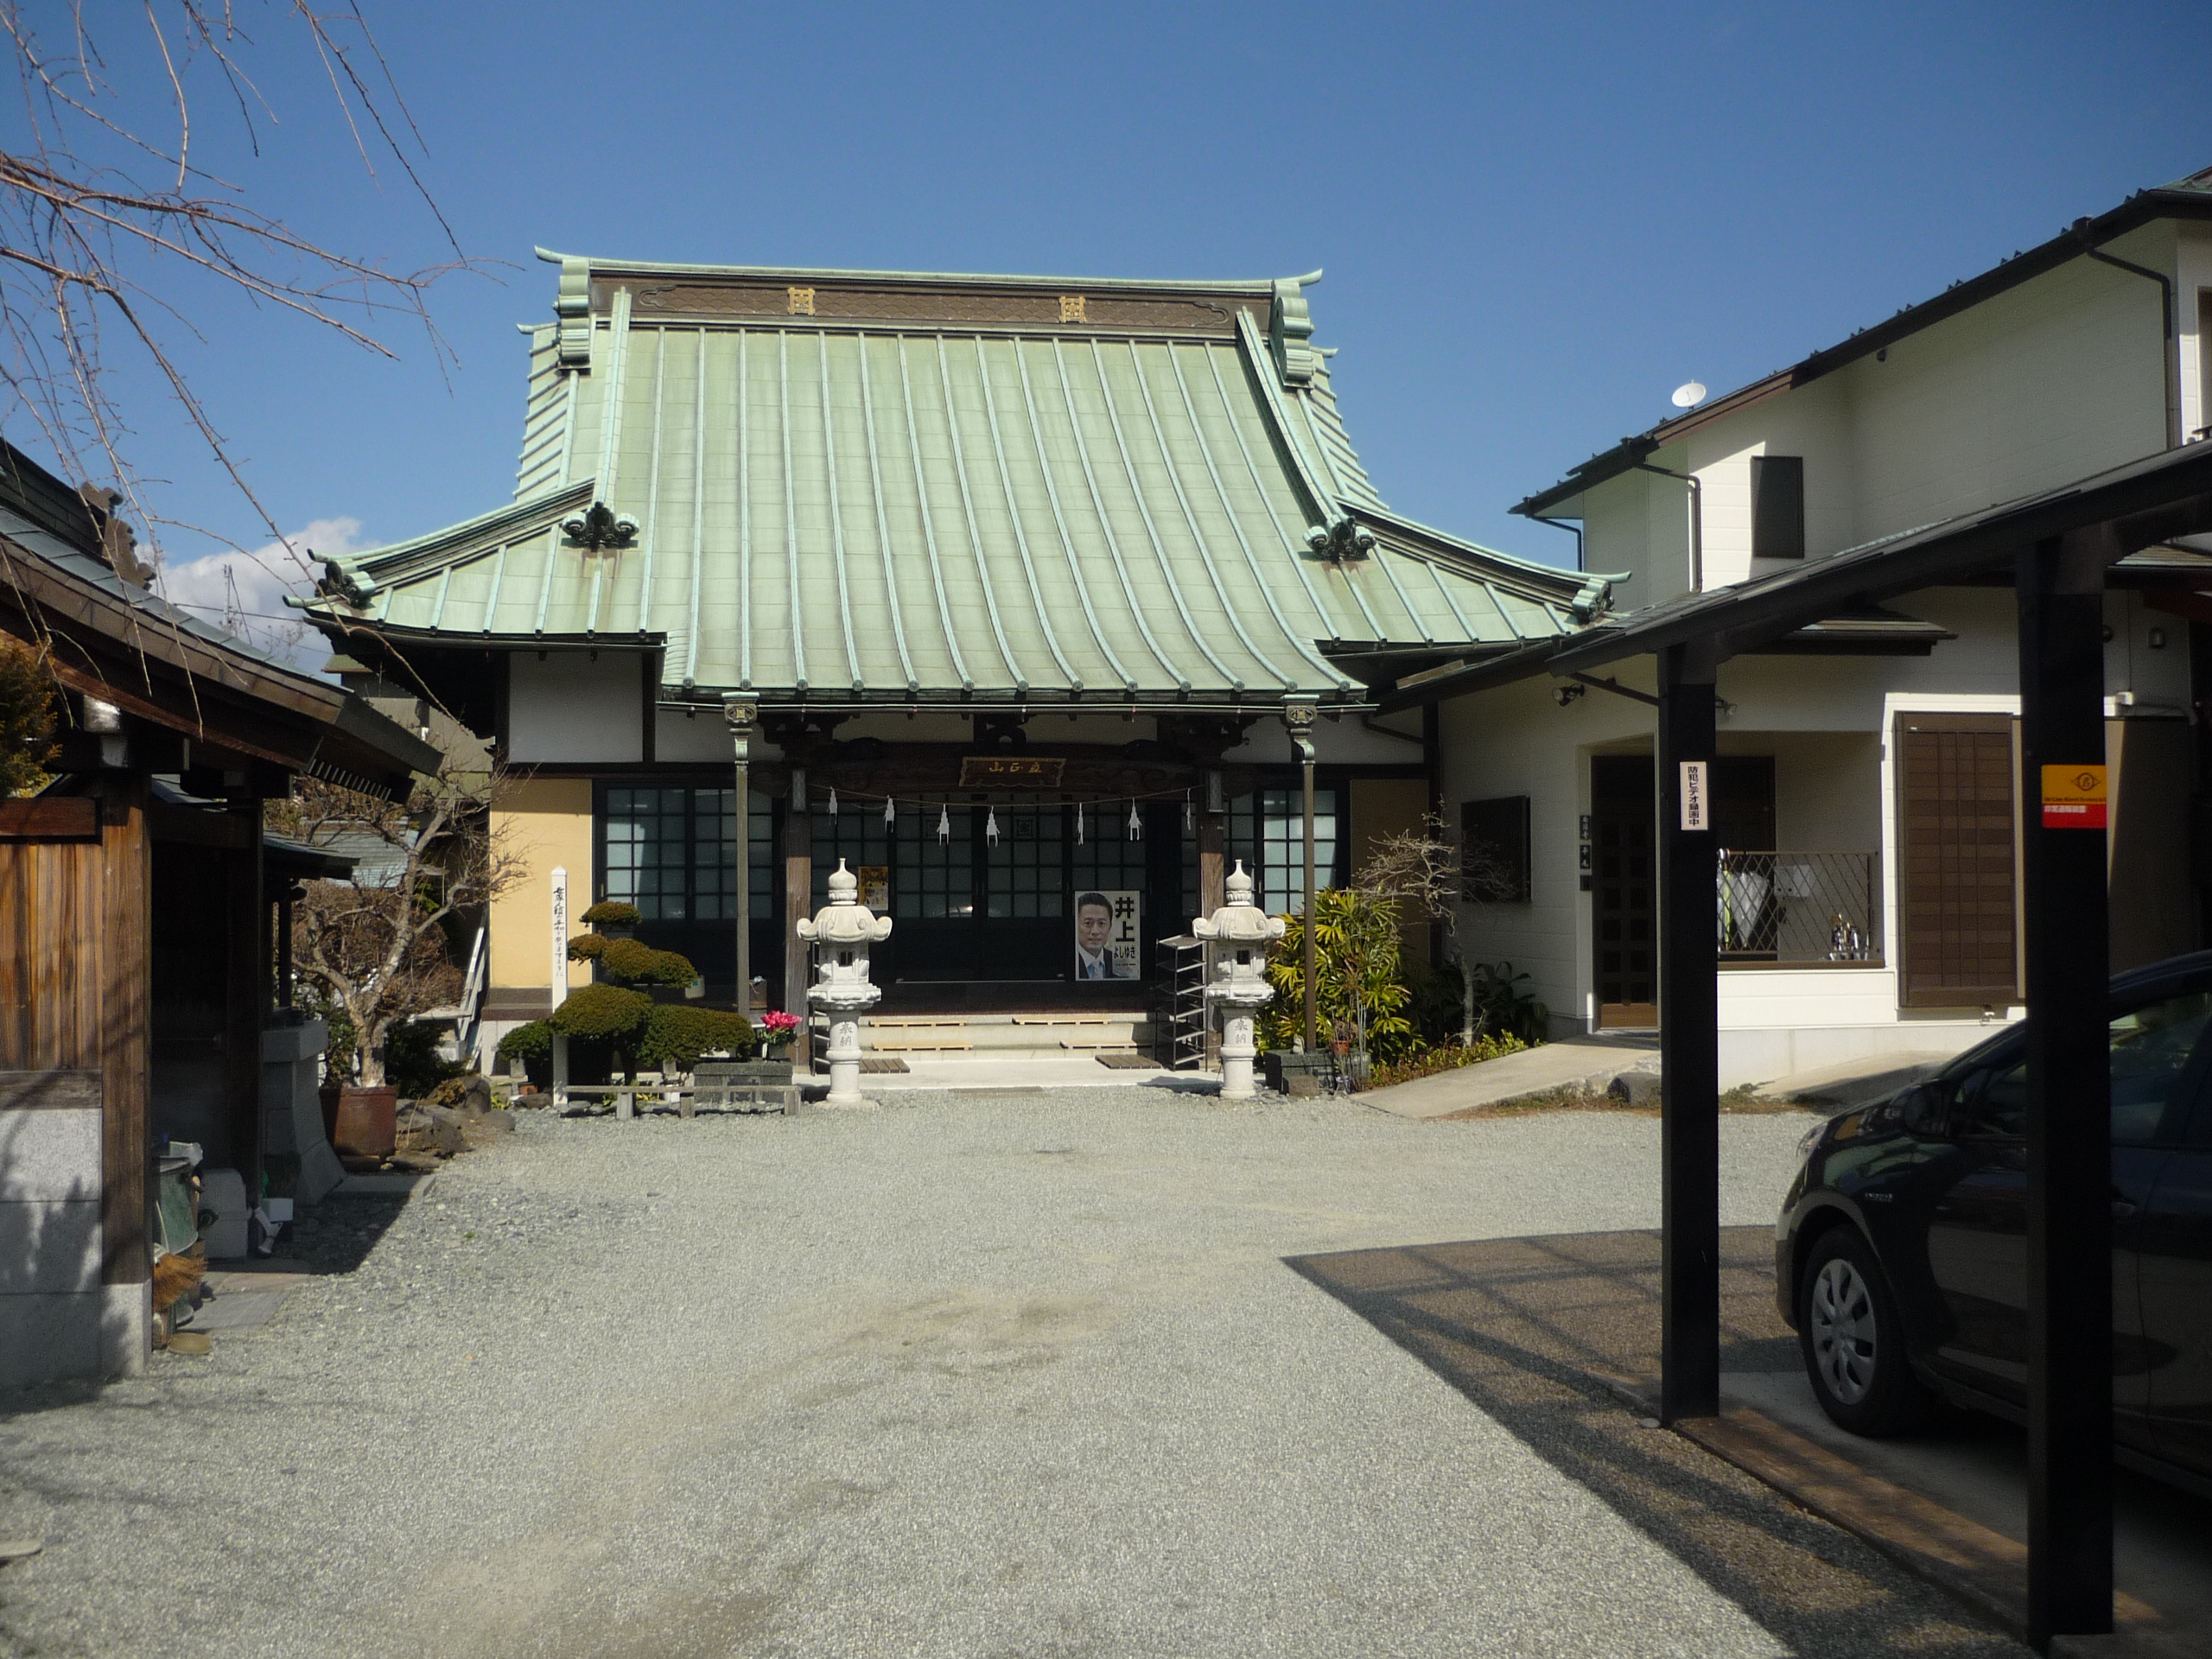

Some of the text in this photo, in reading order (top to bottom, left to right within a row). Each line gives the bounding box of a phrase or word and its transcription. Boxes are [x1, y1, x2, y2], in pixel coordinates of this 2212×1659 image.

[1688, 766, 1700, 826] 防犯ビデオ録画中
[1115, 897, 1135, 942] 井上
[1113, 946, 1136, 960] よしゆき
